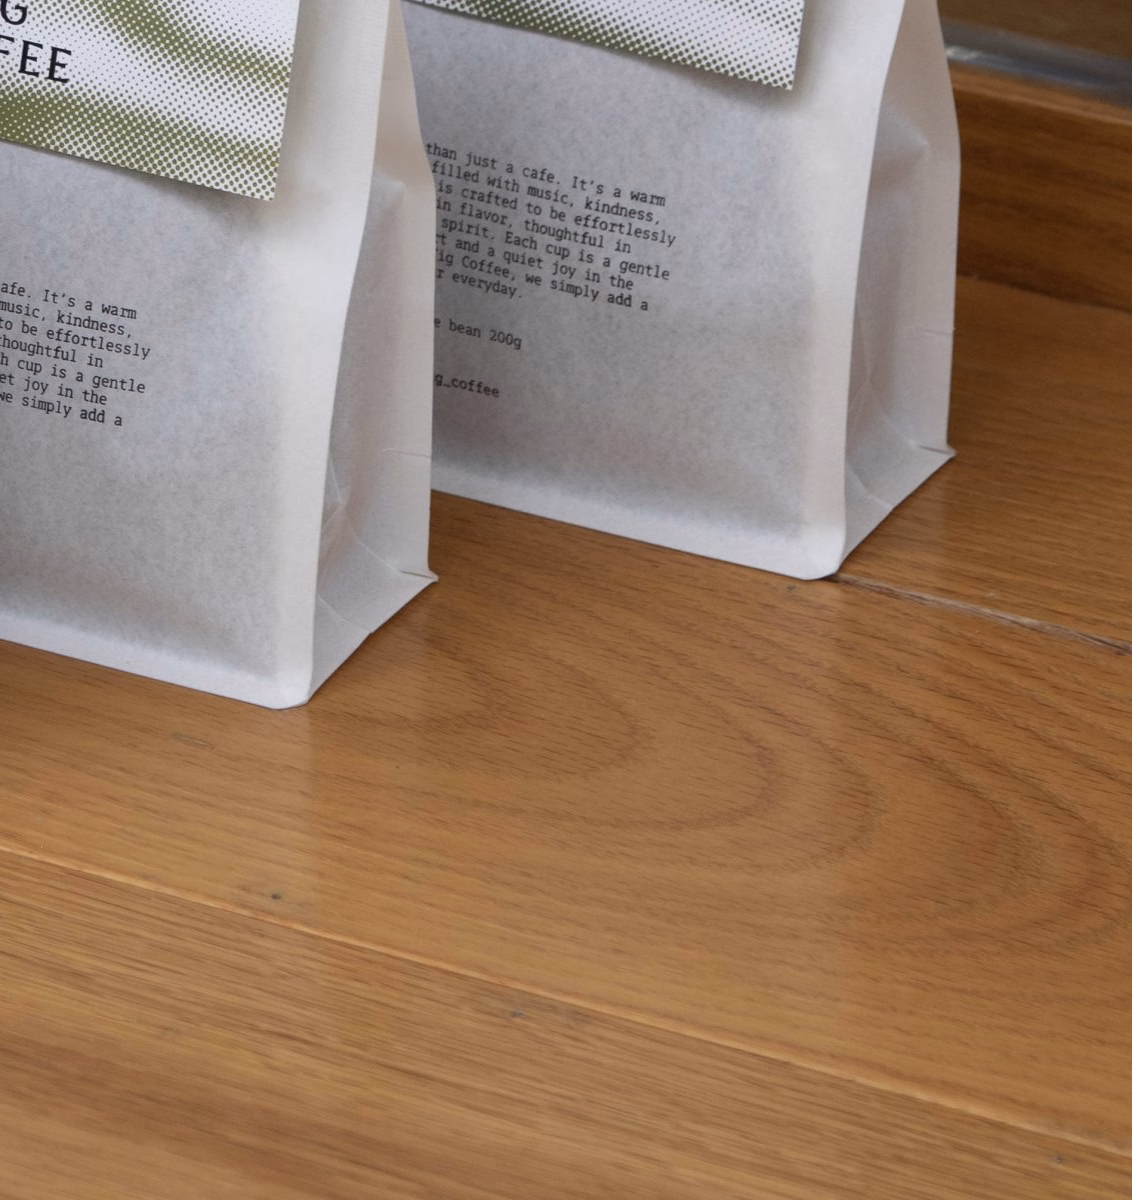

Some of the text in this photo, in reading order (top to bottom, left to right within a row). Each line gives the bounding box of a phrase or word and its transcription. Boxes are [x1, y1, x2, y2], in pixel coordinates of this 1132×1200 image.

[432, 160, 659, 225] filled music, kindness,
[523, 168, 666, 206] cafe. warm
[460, 203, 604, 248] flavor, thoughtful
[462, 188, 676, 248] crafted effortlessly
[442, 218, 494, 239] spirit.
[505, 231, 537, 250] Each
[620, 261, 670, 280] gentle
[452, 273, 522, 298] everyday.
[462, 256, 599, 302] Coffee, simply
[56, 310, 131, 338] kindness,
[102, 304, 137, 320] warm
[46, 328, 151, 360] effortlessly
[450, 319, 481, 338] bean
[490, 329, 522, 350] 200g
[92, 376, 145, 394] gentle
[434, 374, 499, 397] g_coffee
[22, 396, 72, 418] simply
